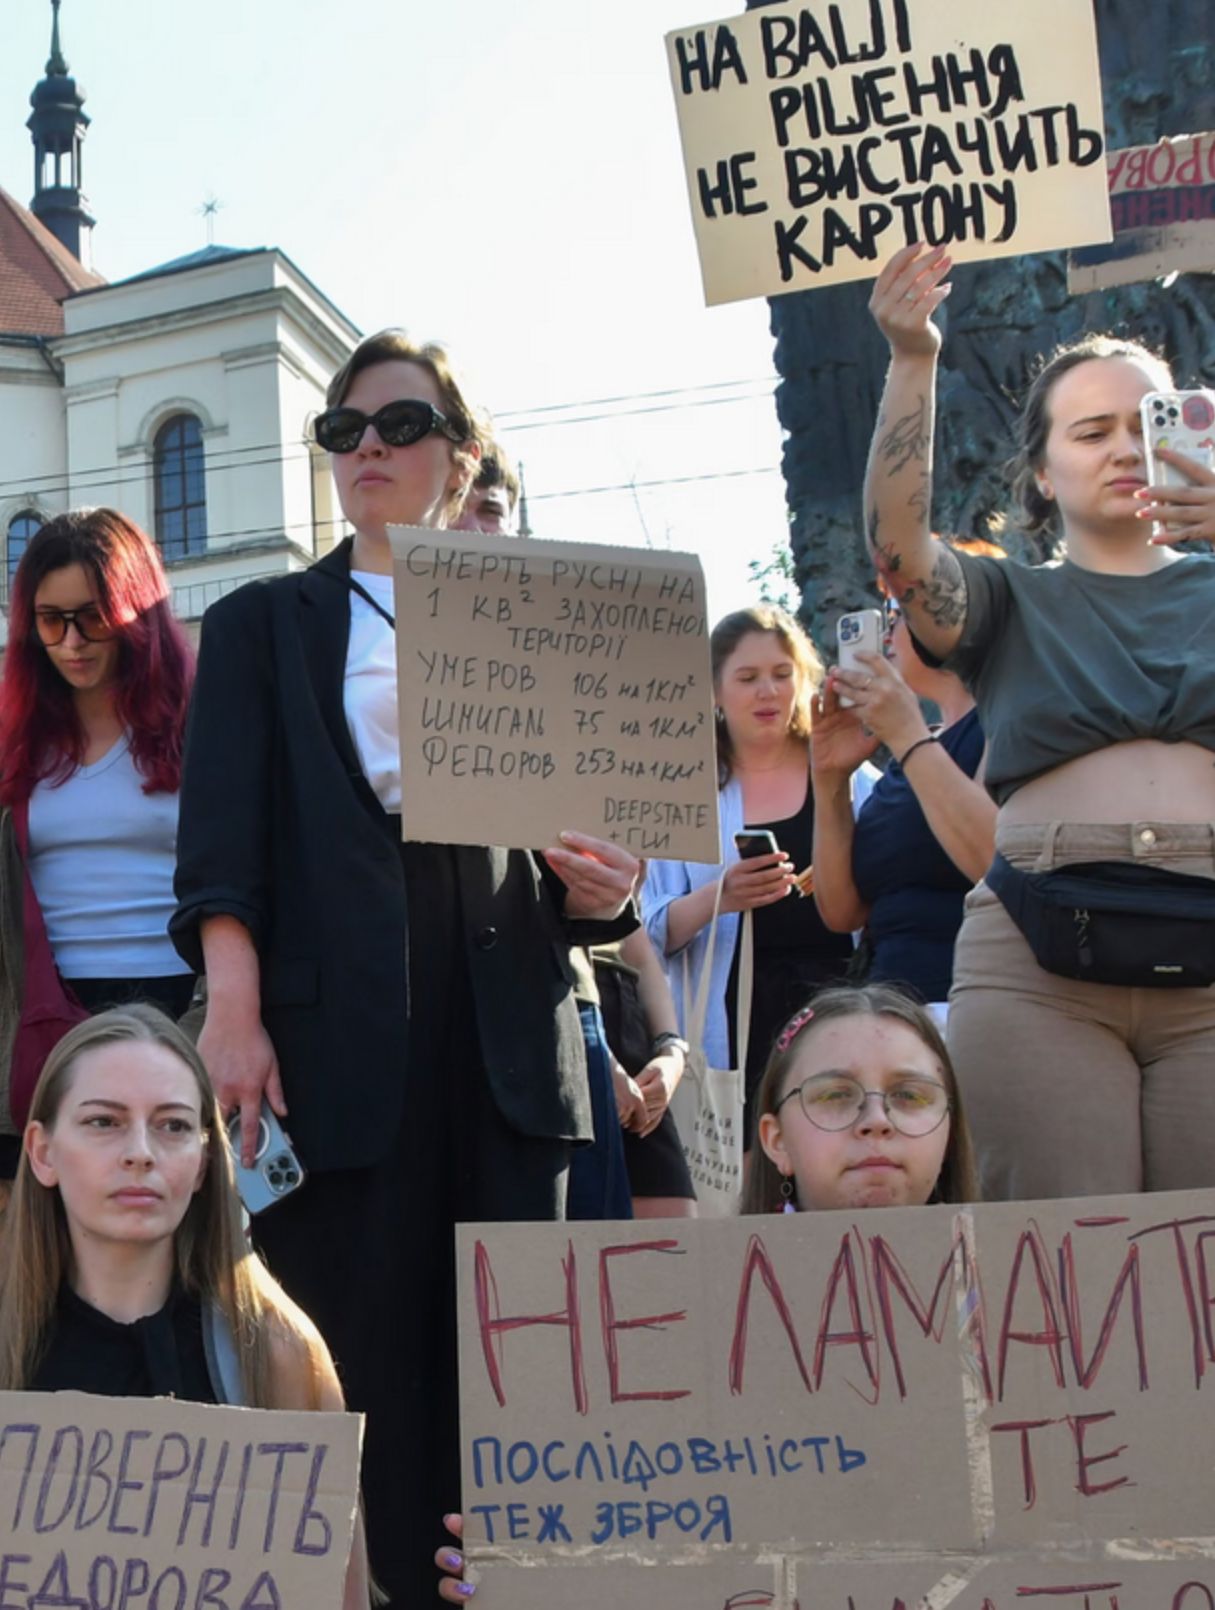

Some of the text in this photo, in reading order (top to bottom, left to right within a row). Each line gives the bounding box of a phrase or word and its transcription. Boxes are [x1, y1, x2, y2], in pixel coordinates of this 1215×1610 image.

[674, 0, 912, 95] НА ВАШІ
[769, 43, 1026, 148] РІШЕННЯ
[696, 102, 1104, 219] НЕ ВИСТАЧИТЬ
[773, 178, 1018, 283] КАРТОНУ
[405, 543, 696, 604] СМЕРТЬ РУСНІ НА
[427, 587, 440, 618] 1
[507, 626, 629, 661] ТЕРИТОРІЇ
[417, 649, 538, 694] УМЕРОВ
[572, 671, 609, 701] 106
[573, 708, 606, 736] 75
[421, 735, 556, 779] ФЕДОРОВ
[574, 747, 617, 777] 253
[603, 795, 711, 830] DEEPSTATE
[474, 1238, 692, 1416] НЕ
[472, 1431, 869, 1492] ПОСЛІДОВНІСТЬ
[989, 1410, 1138, 1512] ТЕ
[470, 1494, 734, 1545] ТЕЖ ЗБРОЯ
